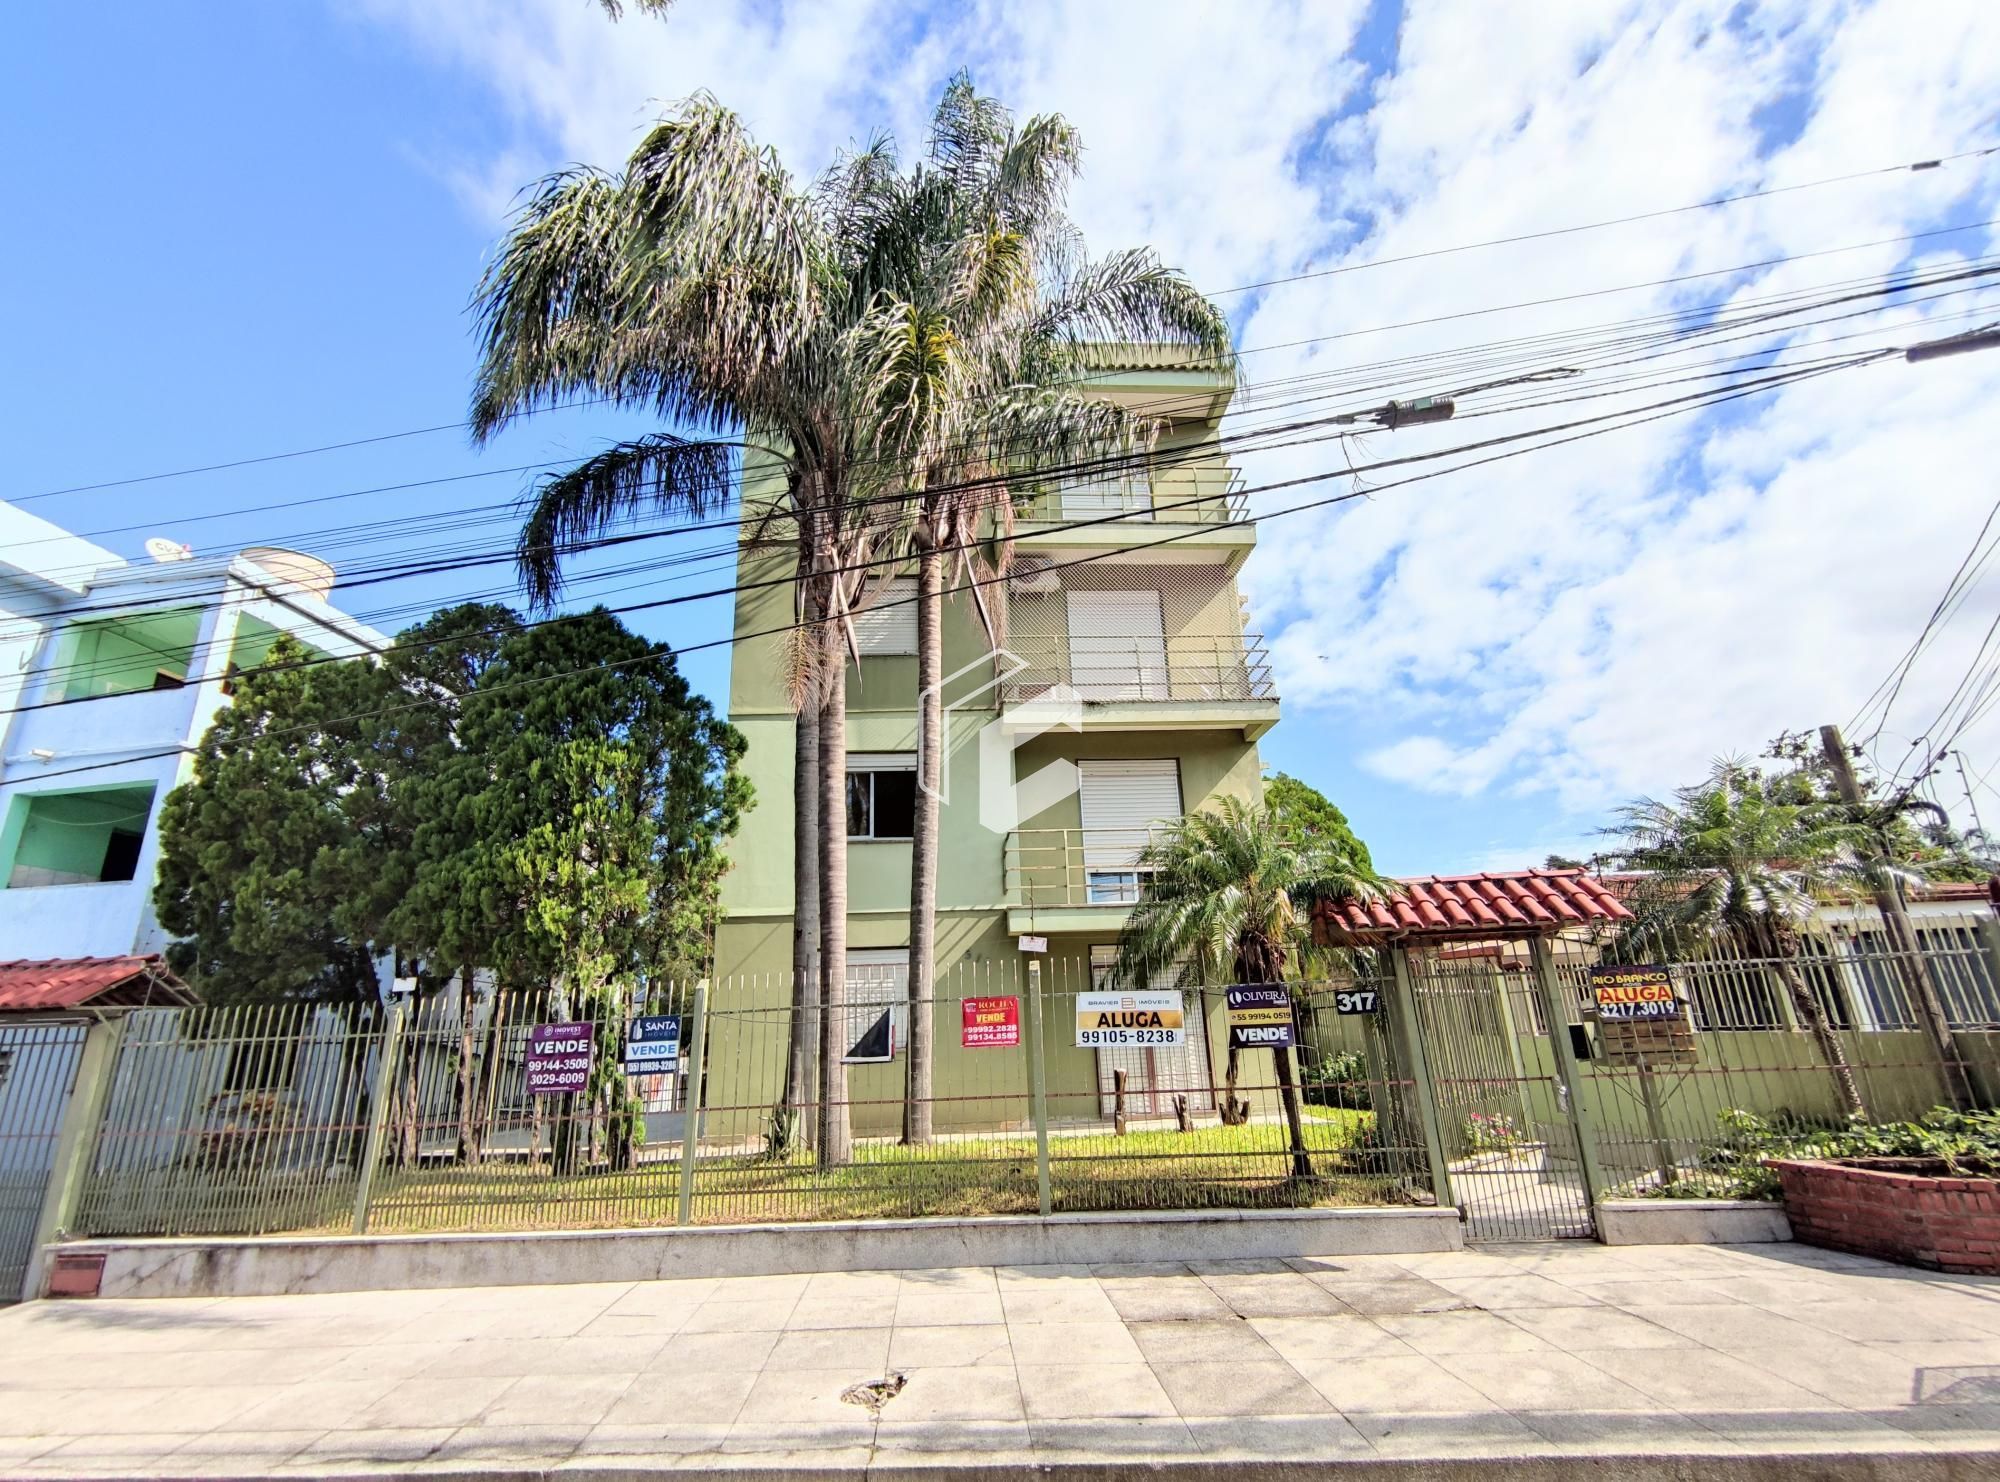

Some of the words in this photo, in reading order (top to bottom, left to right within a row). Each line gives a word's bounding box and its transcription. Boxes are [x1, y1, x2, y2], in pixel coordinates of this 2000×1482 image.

[1592, 976, 1615, 984] RIO
[1616, 972, 1667, 984] BRANCO
[1242, 991, 1287, 1001] OLIVEIRA
[1599, 985, 1671, 1002] ALUGA
[1337, 992, 1375, 1012] 317
[1600, 1001, 1675, 1016] 3217.3019
[976, 1012, 1006, 1023] VENDE
[1097, 1011, 1163, 1028] ALUGA
[1237, 1013, 1247, 1021] 55
[1248, 1012, 1272, 1020] 99194
[645, 1021, 677, 1031] SANTA
[1081, 1030, 1175, 1043] 99105-8238
[1236, 1027, 1289, 1042] VENDE
[534, 1039, 589, 1055] VENDE
[631, 1044, 676, 1056] VENDE
[528, 1058, 588, 1071] 99144-3508
[530, 1072, 585, 1085] 3029-6009
